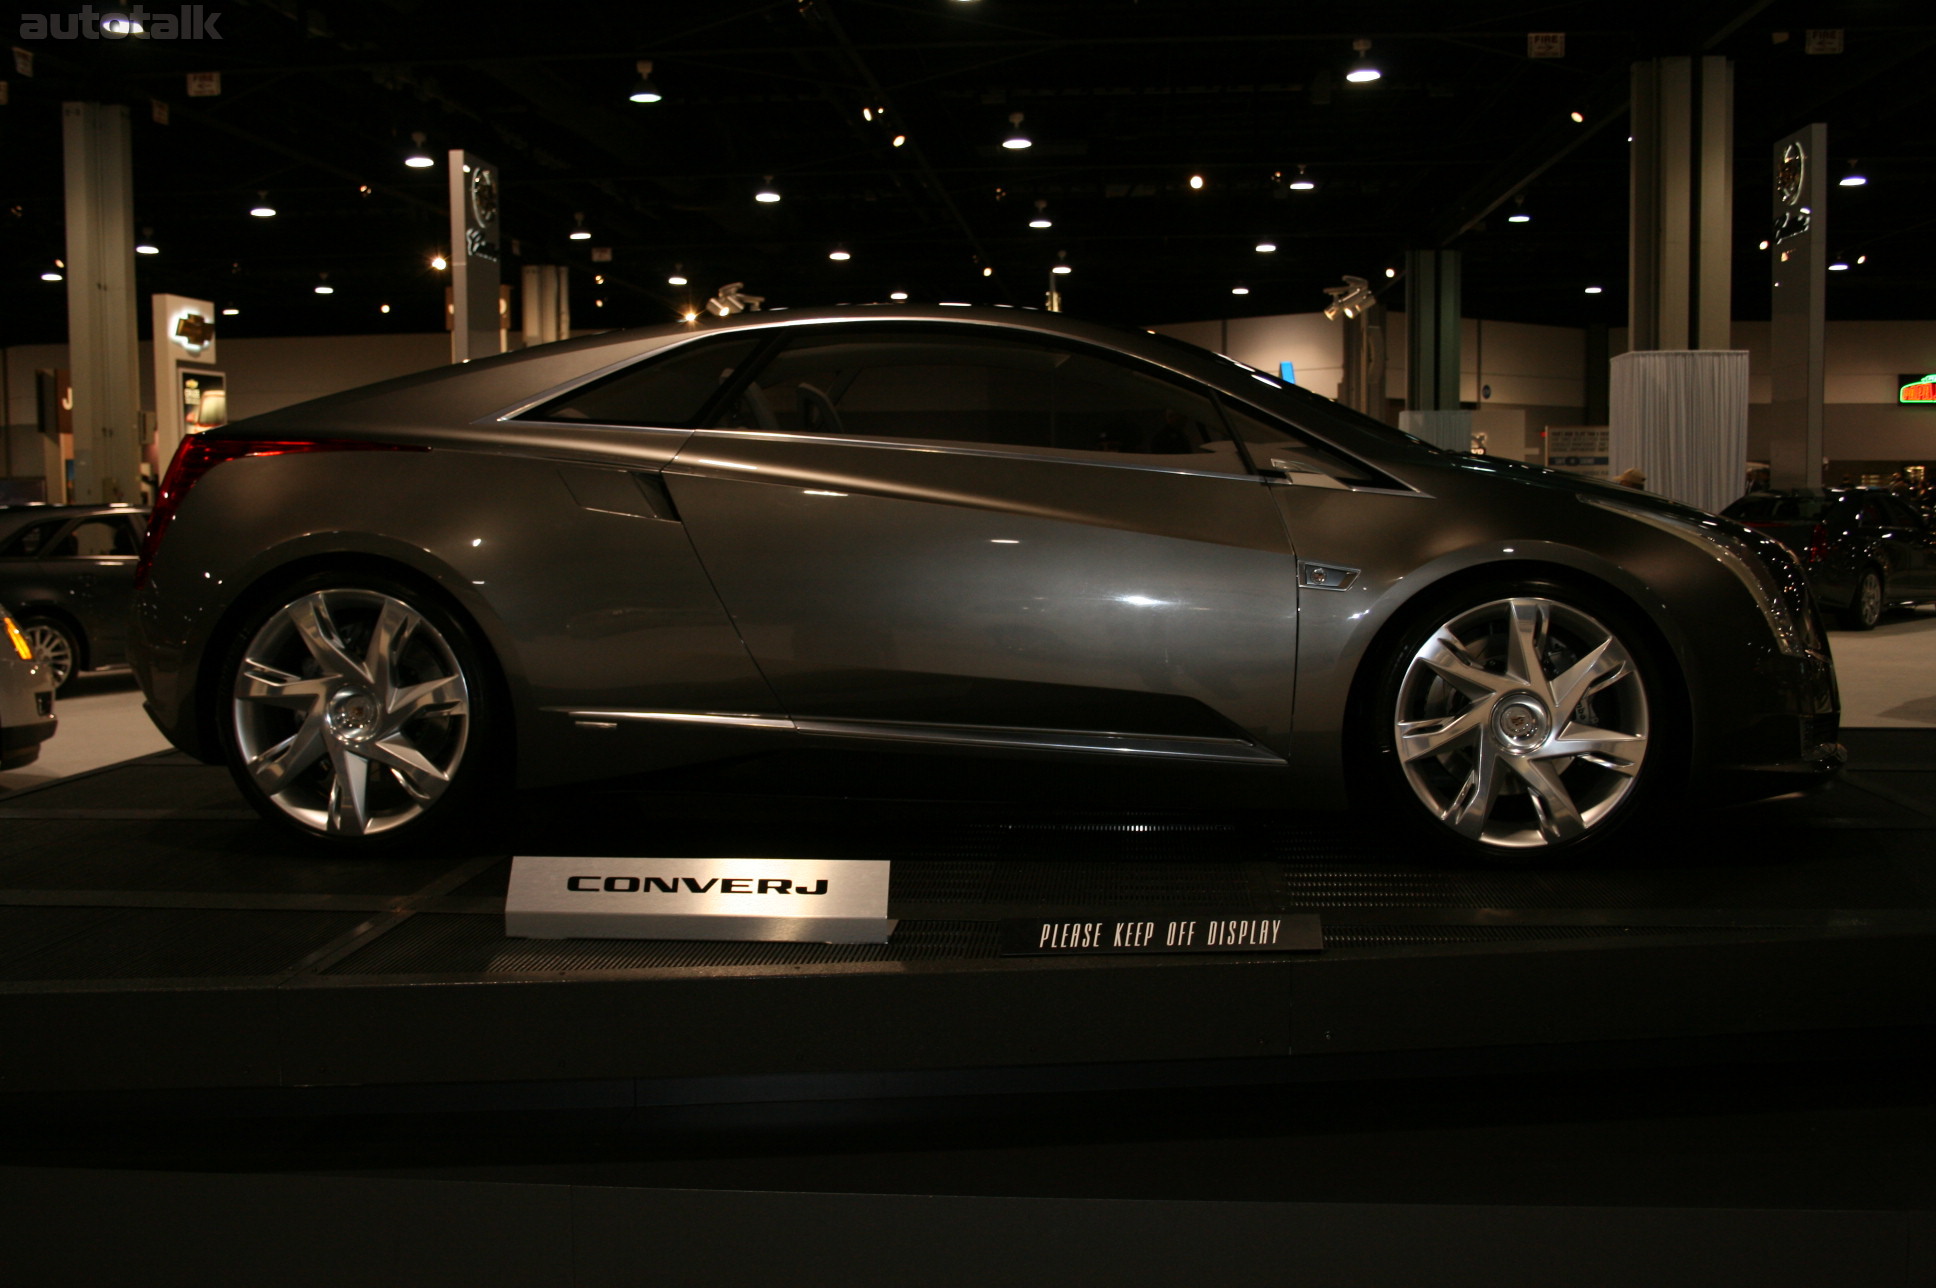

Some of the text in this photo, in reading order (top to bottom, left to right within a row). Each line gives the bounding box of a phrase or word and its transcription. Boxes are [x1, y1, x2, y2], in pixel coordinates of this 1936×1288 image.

[1534, 35, 1558, 44] FIRE
[1812, 30, 1837, 39] FIRE
[567, 876, 829, 895] CONVERJ
[1039, 919, 1281, 948] PLEASE KEEP OFF DISPLAY
